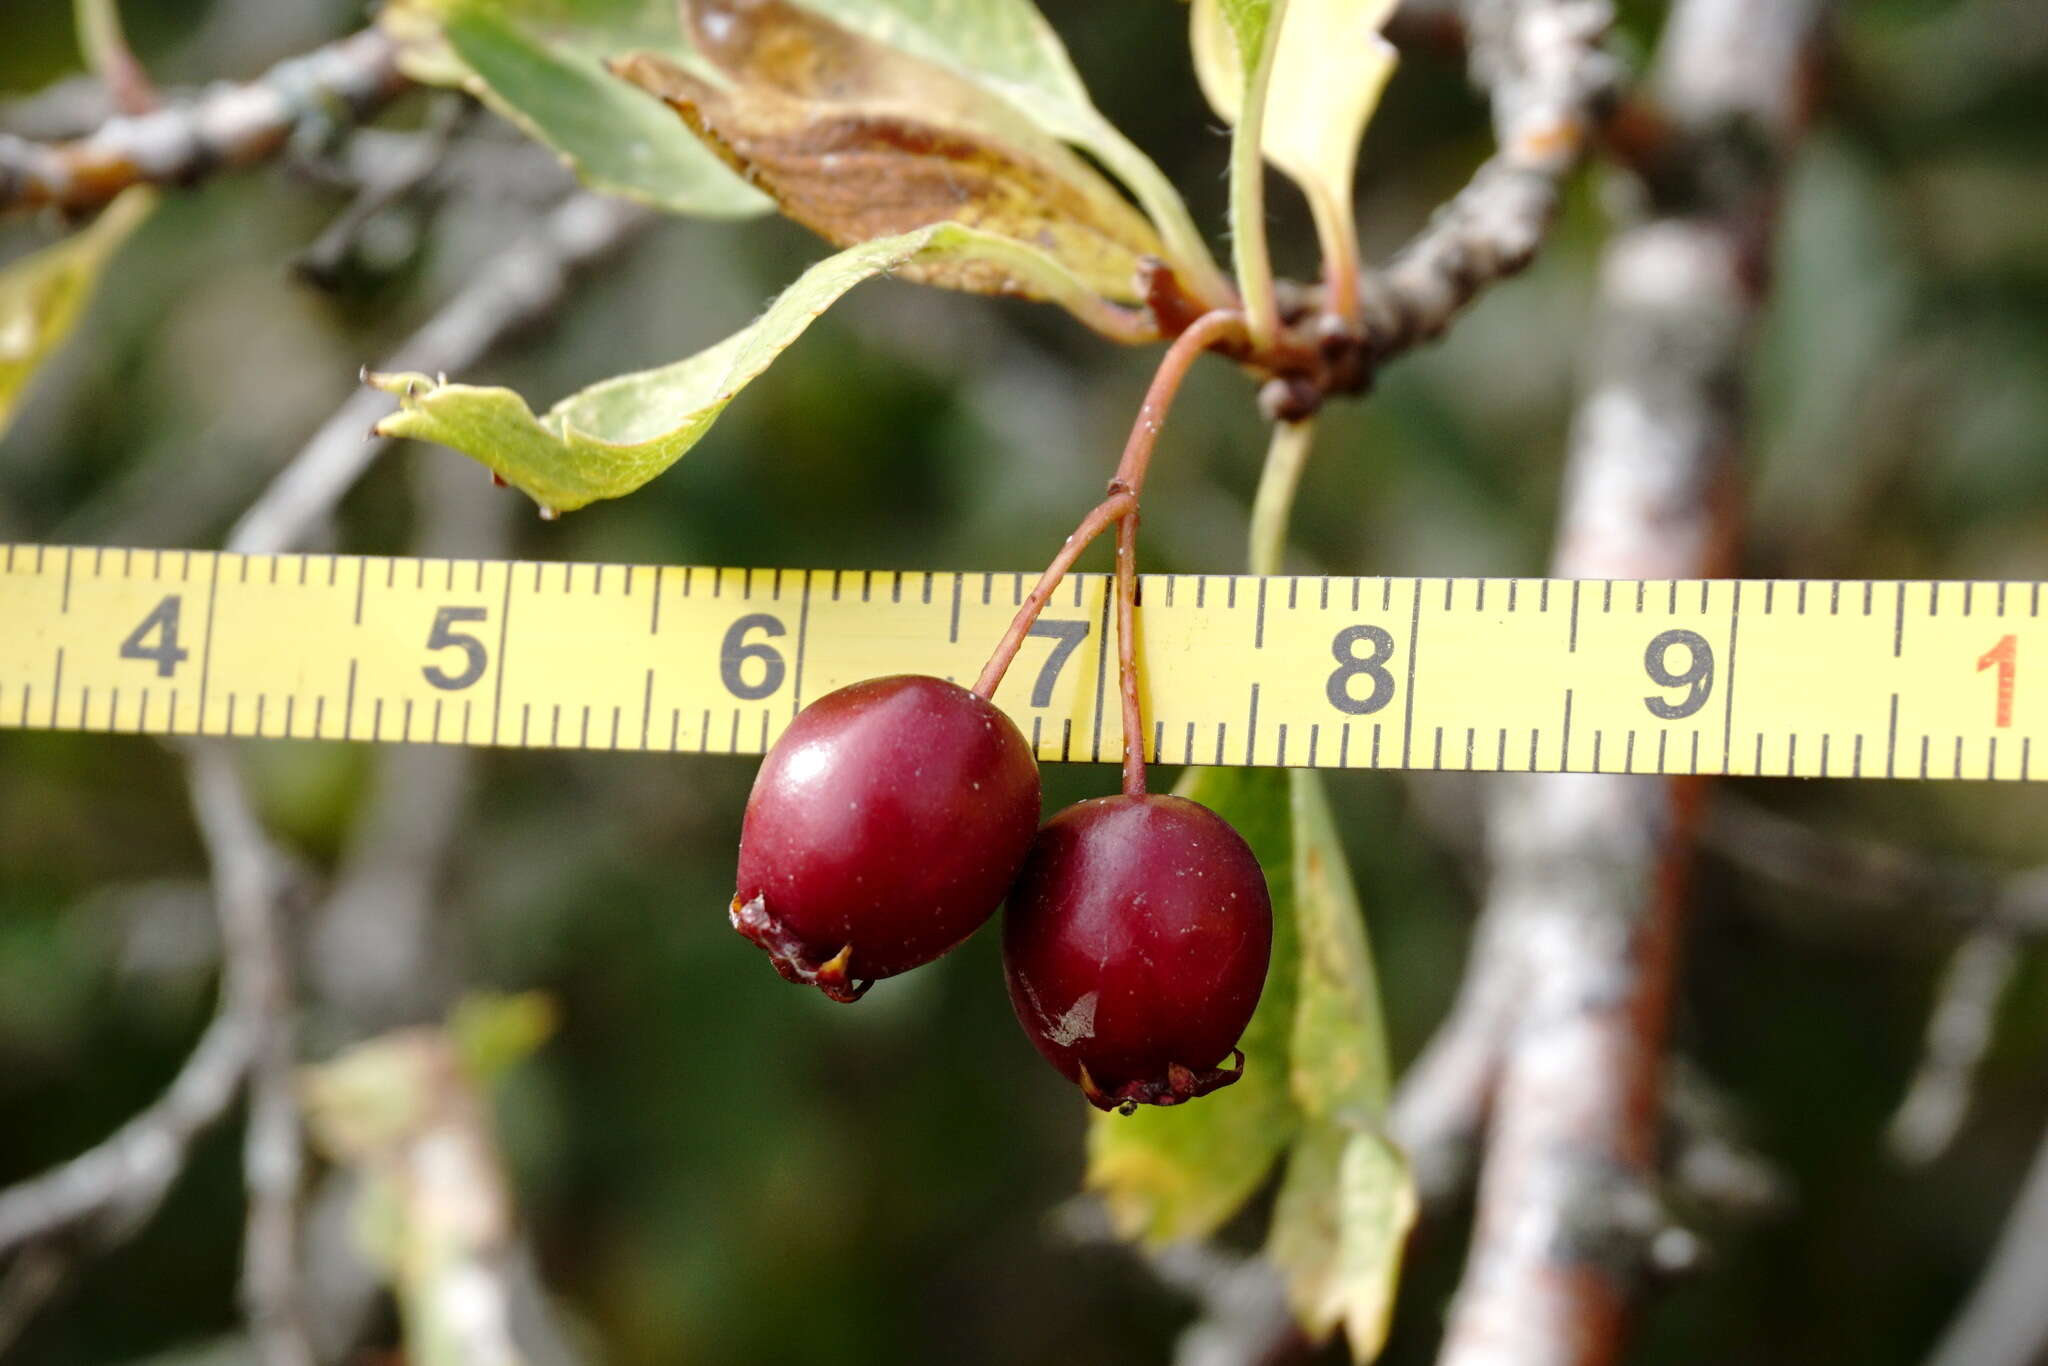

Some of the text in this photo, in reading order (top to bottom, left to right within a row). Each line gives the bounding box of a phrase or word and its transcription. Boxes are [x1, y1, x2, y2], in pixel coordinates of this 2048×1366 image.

[119, 595, 2018, 728] 4 5 6 7 8 9 1
